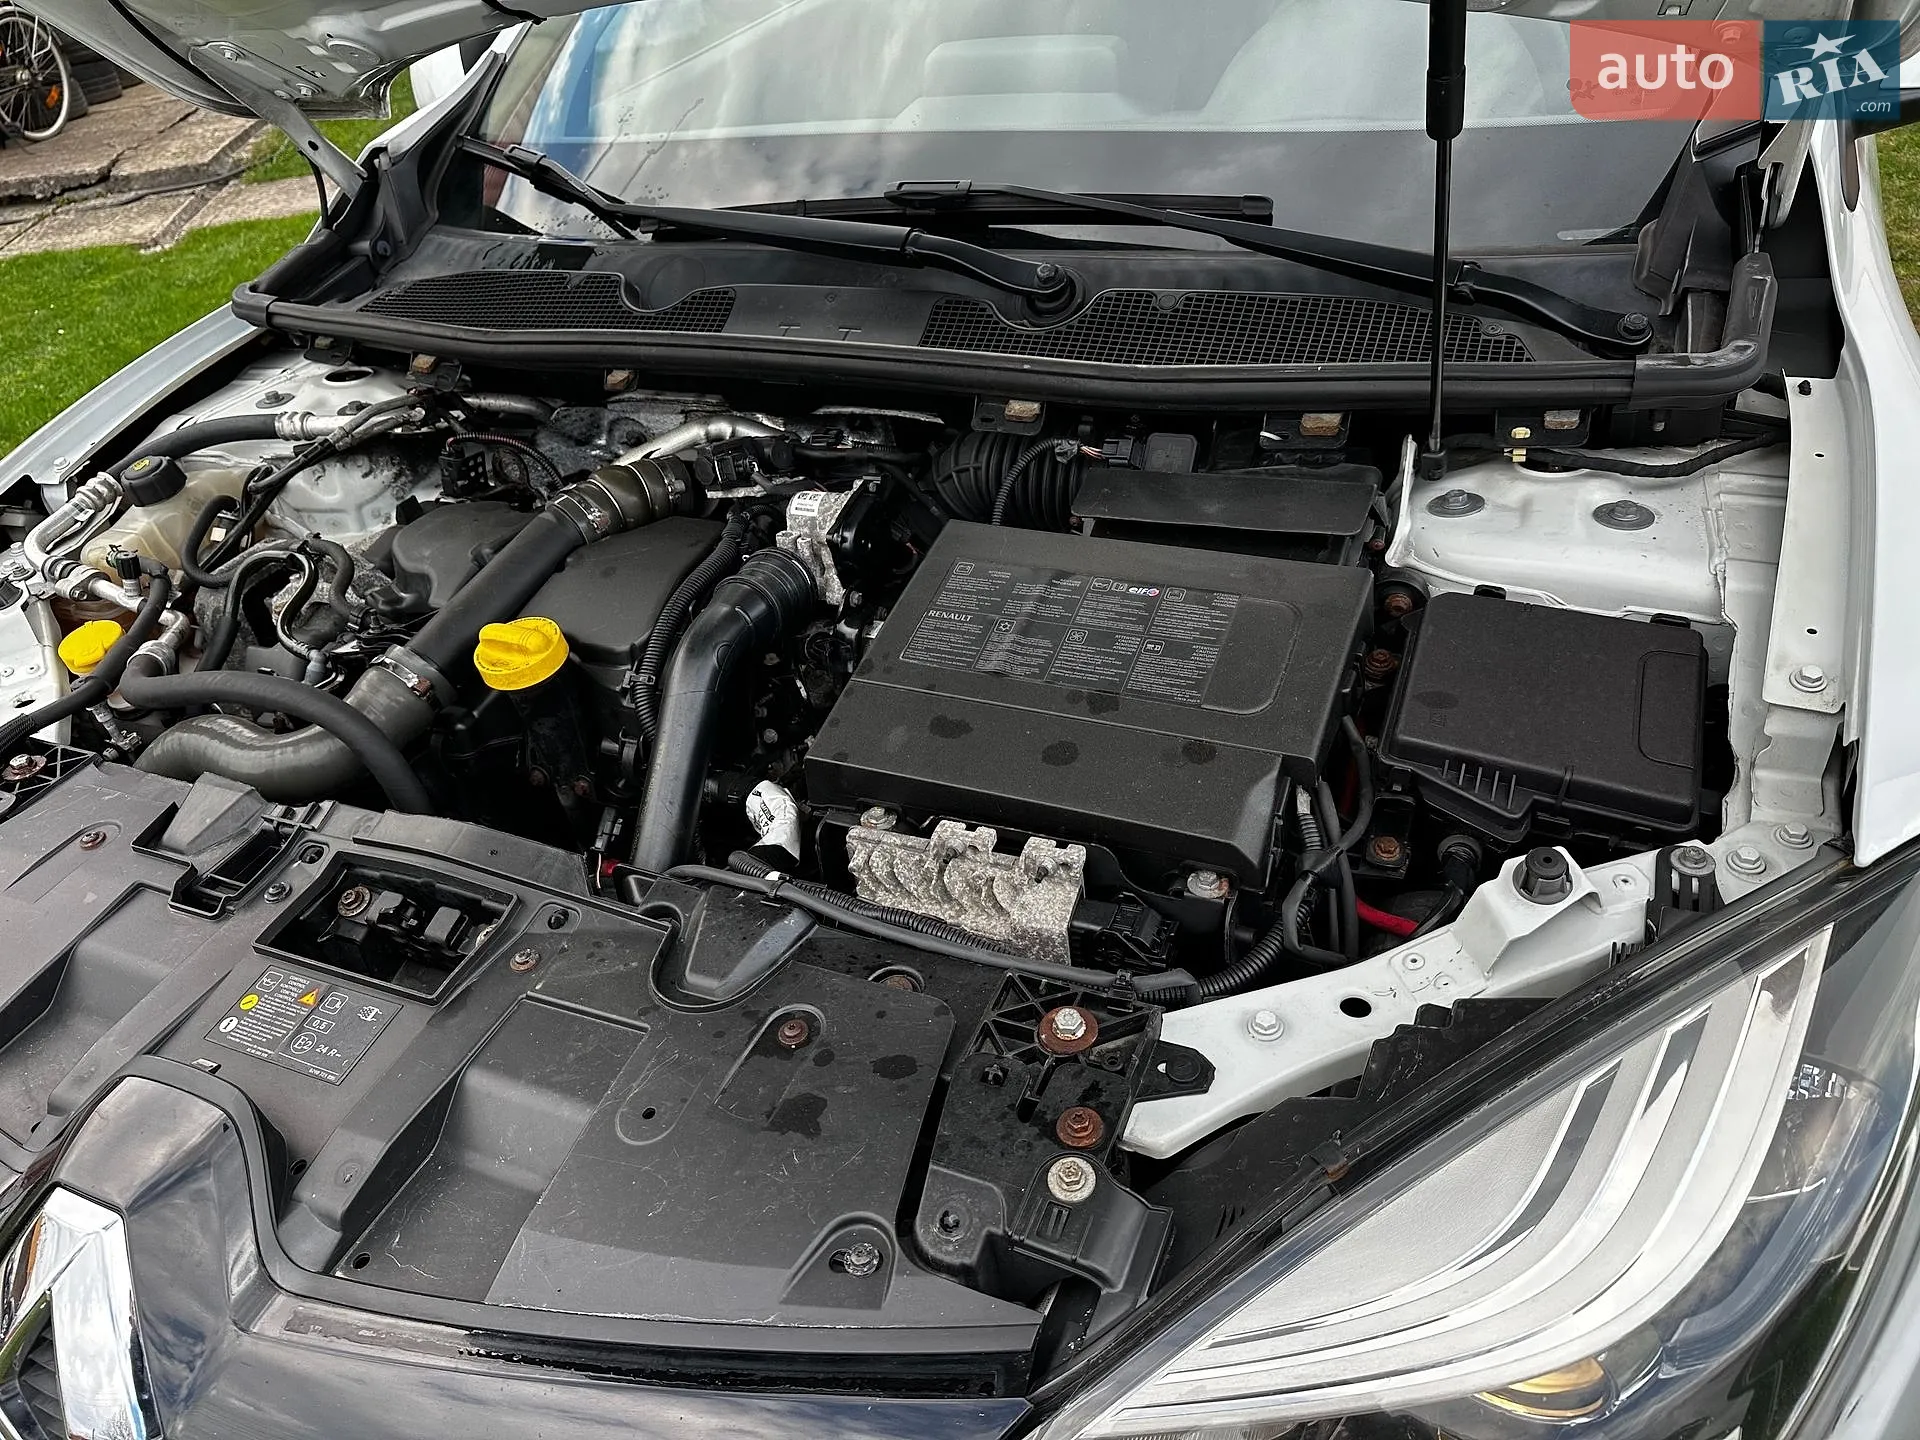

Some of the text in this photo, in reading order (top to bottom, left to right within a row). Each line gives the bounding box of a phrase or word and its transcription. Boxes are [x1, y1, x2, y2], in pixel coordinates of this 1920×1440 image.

[1128, 586, 1150, 597] elf
[927, 609, 973, 621] RENAULT
[313, 1020, 327, 1029] 0,5
[294, 1036, 312, 1049] E2
[316, 1045, 329, 1054] 24
